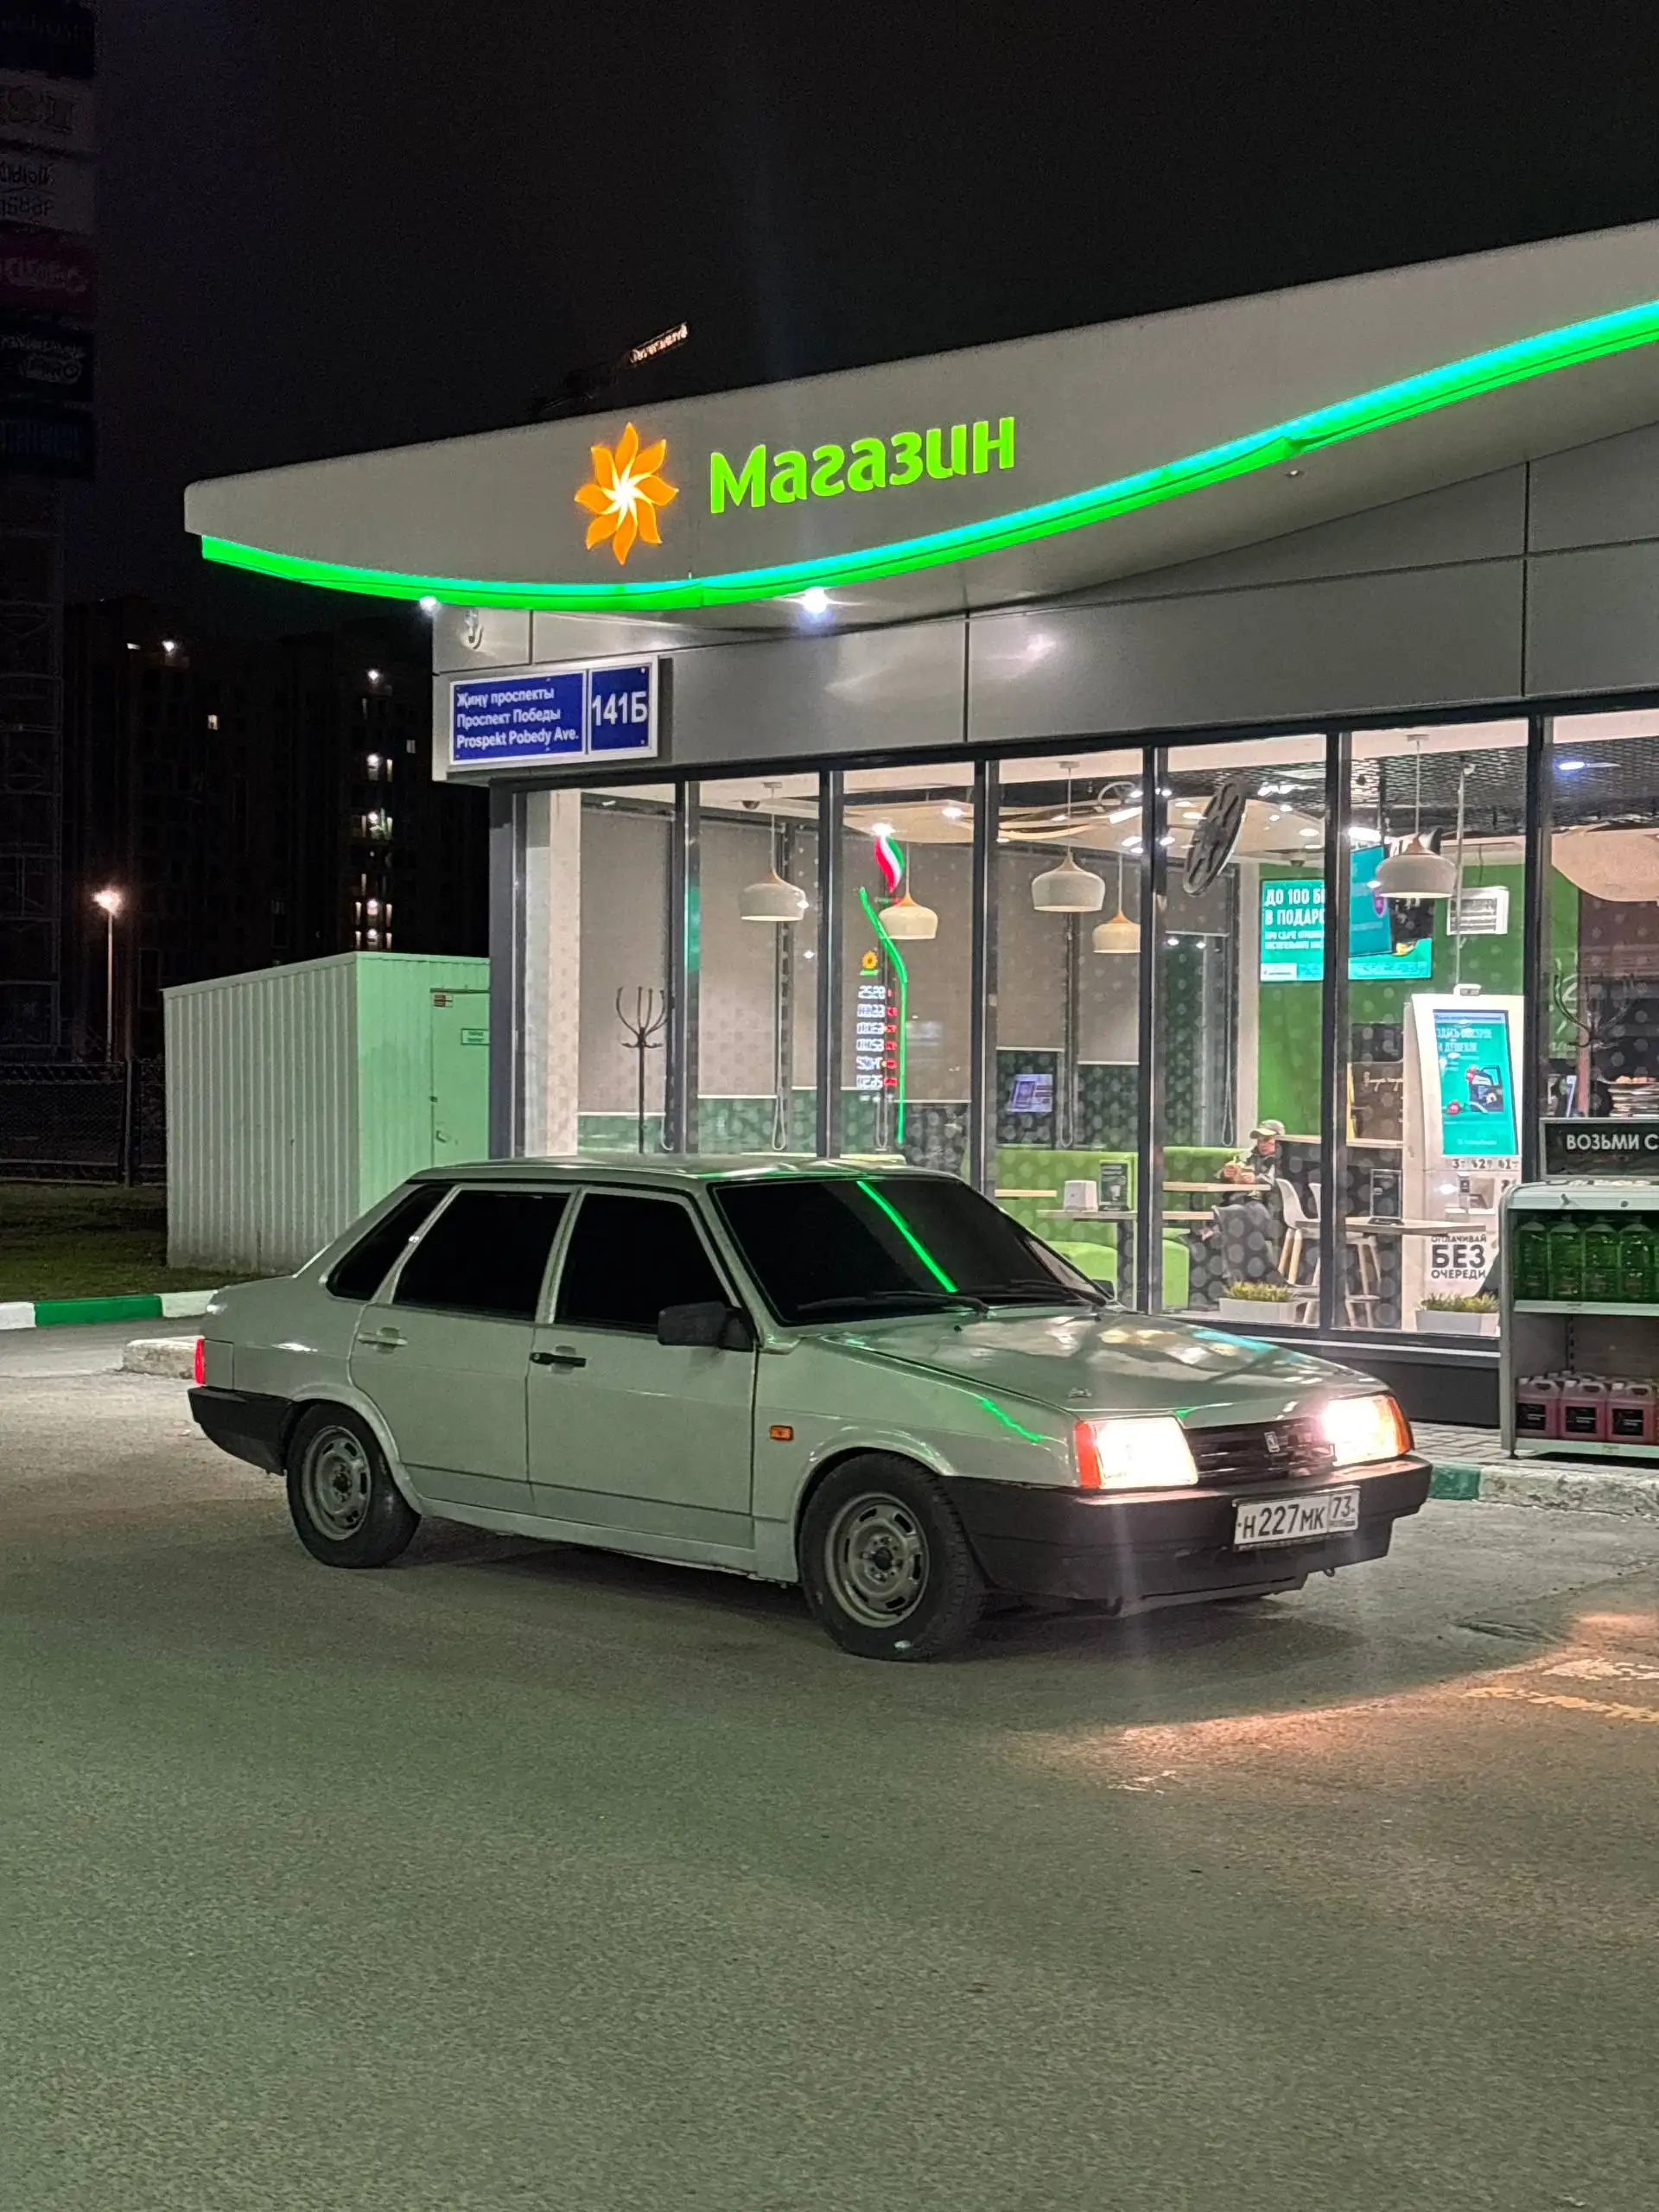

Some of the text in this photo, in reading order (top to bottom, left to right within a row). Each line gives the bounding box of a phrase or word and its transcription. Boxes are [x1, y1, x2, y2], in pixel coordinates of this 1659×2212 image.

[710, 416, 1014, 514] Магазин
[491, 688, 555, 707] проспекты
[592, 691, 648, 726] 141Б
[457, 707, 561, 730] Проспект Победы
[456, 726, 579, 750] Prospekt Pobedy Ave.
[1264, 888, 1284, 906] ДО
[1287, 888, 1310, 905] 100
[1566, 1134, 1640, 1150] ВОЗЬМИ
[1432, 1244, 1485, 1268] БЕЗ
[1431, 1269, 1486, 1280] ОЧЕРЕДИ
[1332, 1495, 1352, 1518] 73
